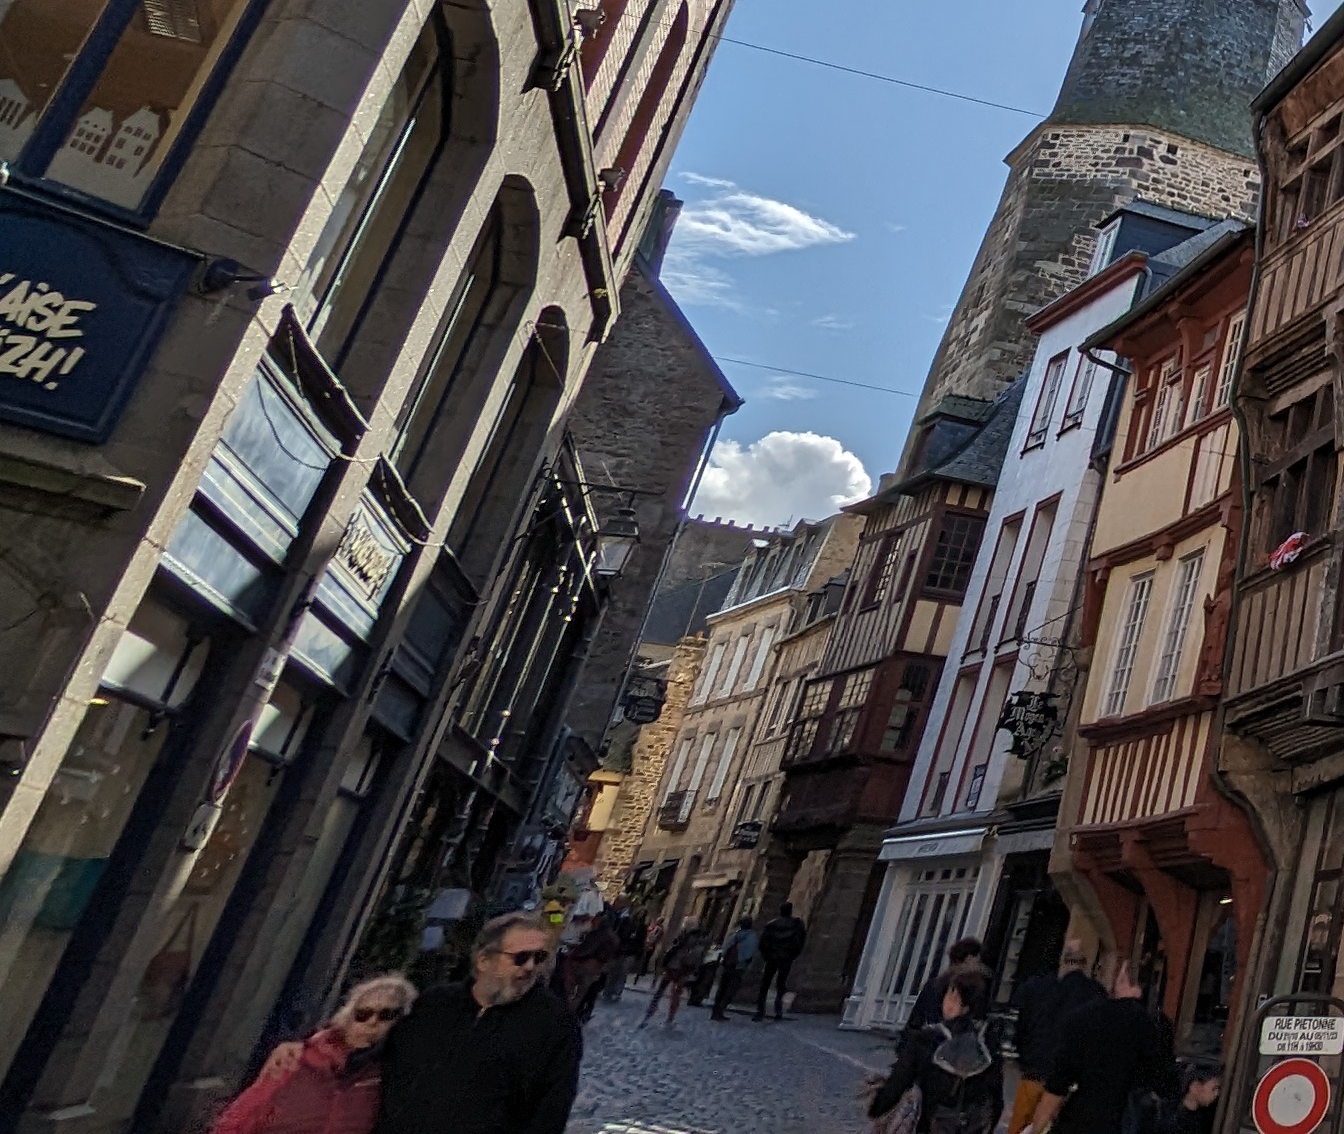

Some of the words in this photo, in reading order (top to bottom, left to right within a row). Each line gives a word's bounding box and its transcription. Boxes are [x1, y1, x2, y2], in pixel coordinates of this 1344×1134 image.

[1274, 1018, 1293, 1030] RUE
[1268, 1031, 1284, 1041] DU
[1299, 1032, 1314, 1041] AU
